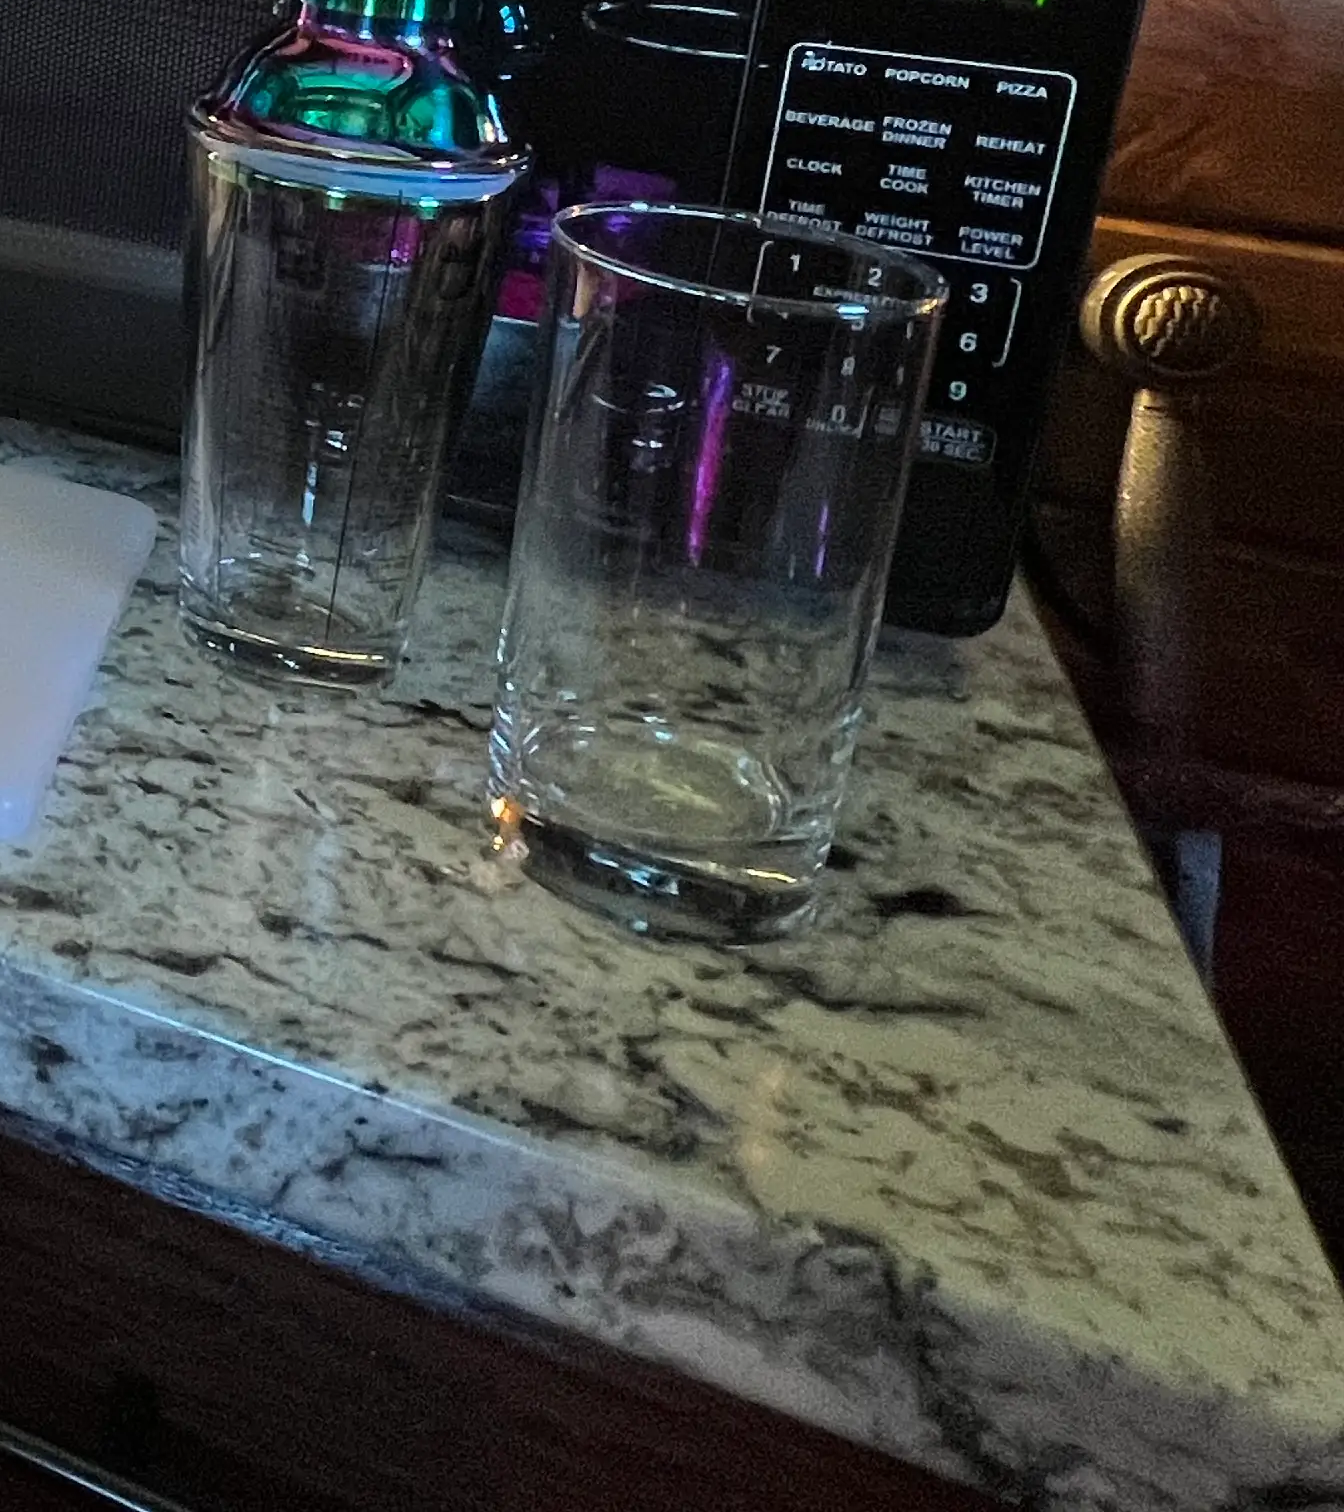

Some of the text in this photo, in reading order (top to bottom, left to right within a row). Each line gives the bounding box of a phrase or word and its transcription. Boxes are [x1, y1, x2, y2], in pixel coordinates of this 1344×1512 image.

[885, 67, 971, 90] POPCORN
[996, 80, 1048, 100] PIZZA
[785, 109, 876, 134] BEVERAGE
[882, 115, 953, 136] FROZEN
[881, 131, 947, 151] DINNER
[976, 134, 1047, 156] REHEAT
[786, 157, 844, 177] CLOCK
[888, 164, 928, 181] TIME
[880, 176, 929, 195] COOK
[964, 174, 1042, 197] KITCHEN
[788, 199, 826, 215] TIME
[973, 190, 1025, 210] TIMER
[864, 210, 932, 234] WEIGHT
[856, 224, 934, 249] DEFROST
[958, 225, 1025, 248] POWER
[960, 240, 1016, 261] LEVEL
[868, 267, 883, 288] 2
[970, 283, 990, 304] 3
[959, 332, 978, 353] 6
[765, 345, 782, 365] 7
[948, 381, 968, 402] 9
[919, 419, 984, 444] START
